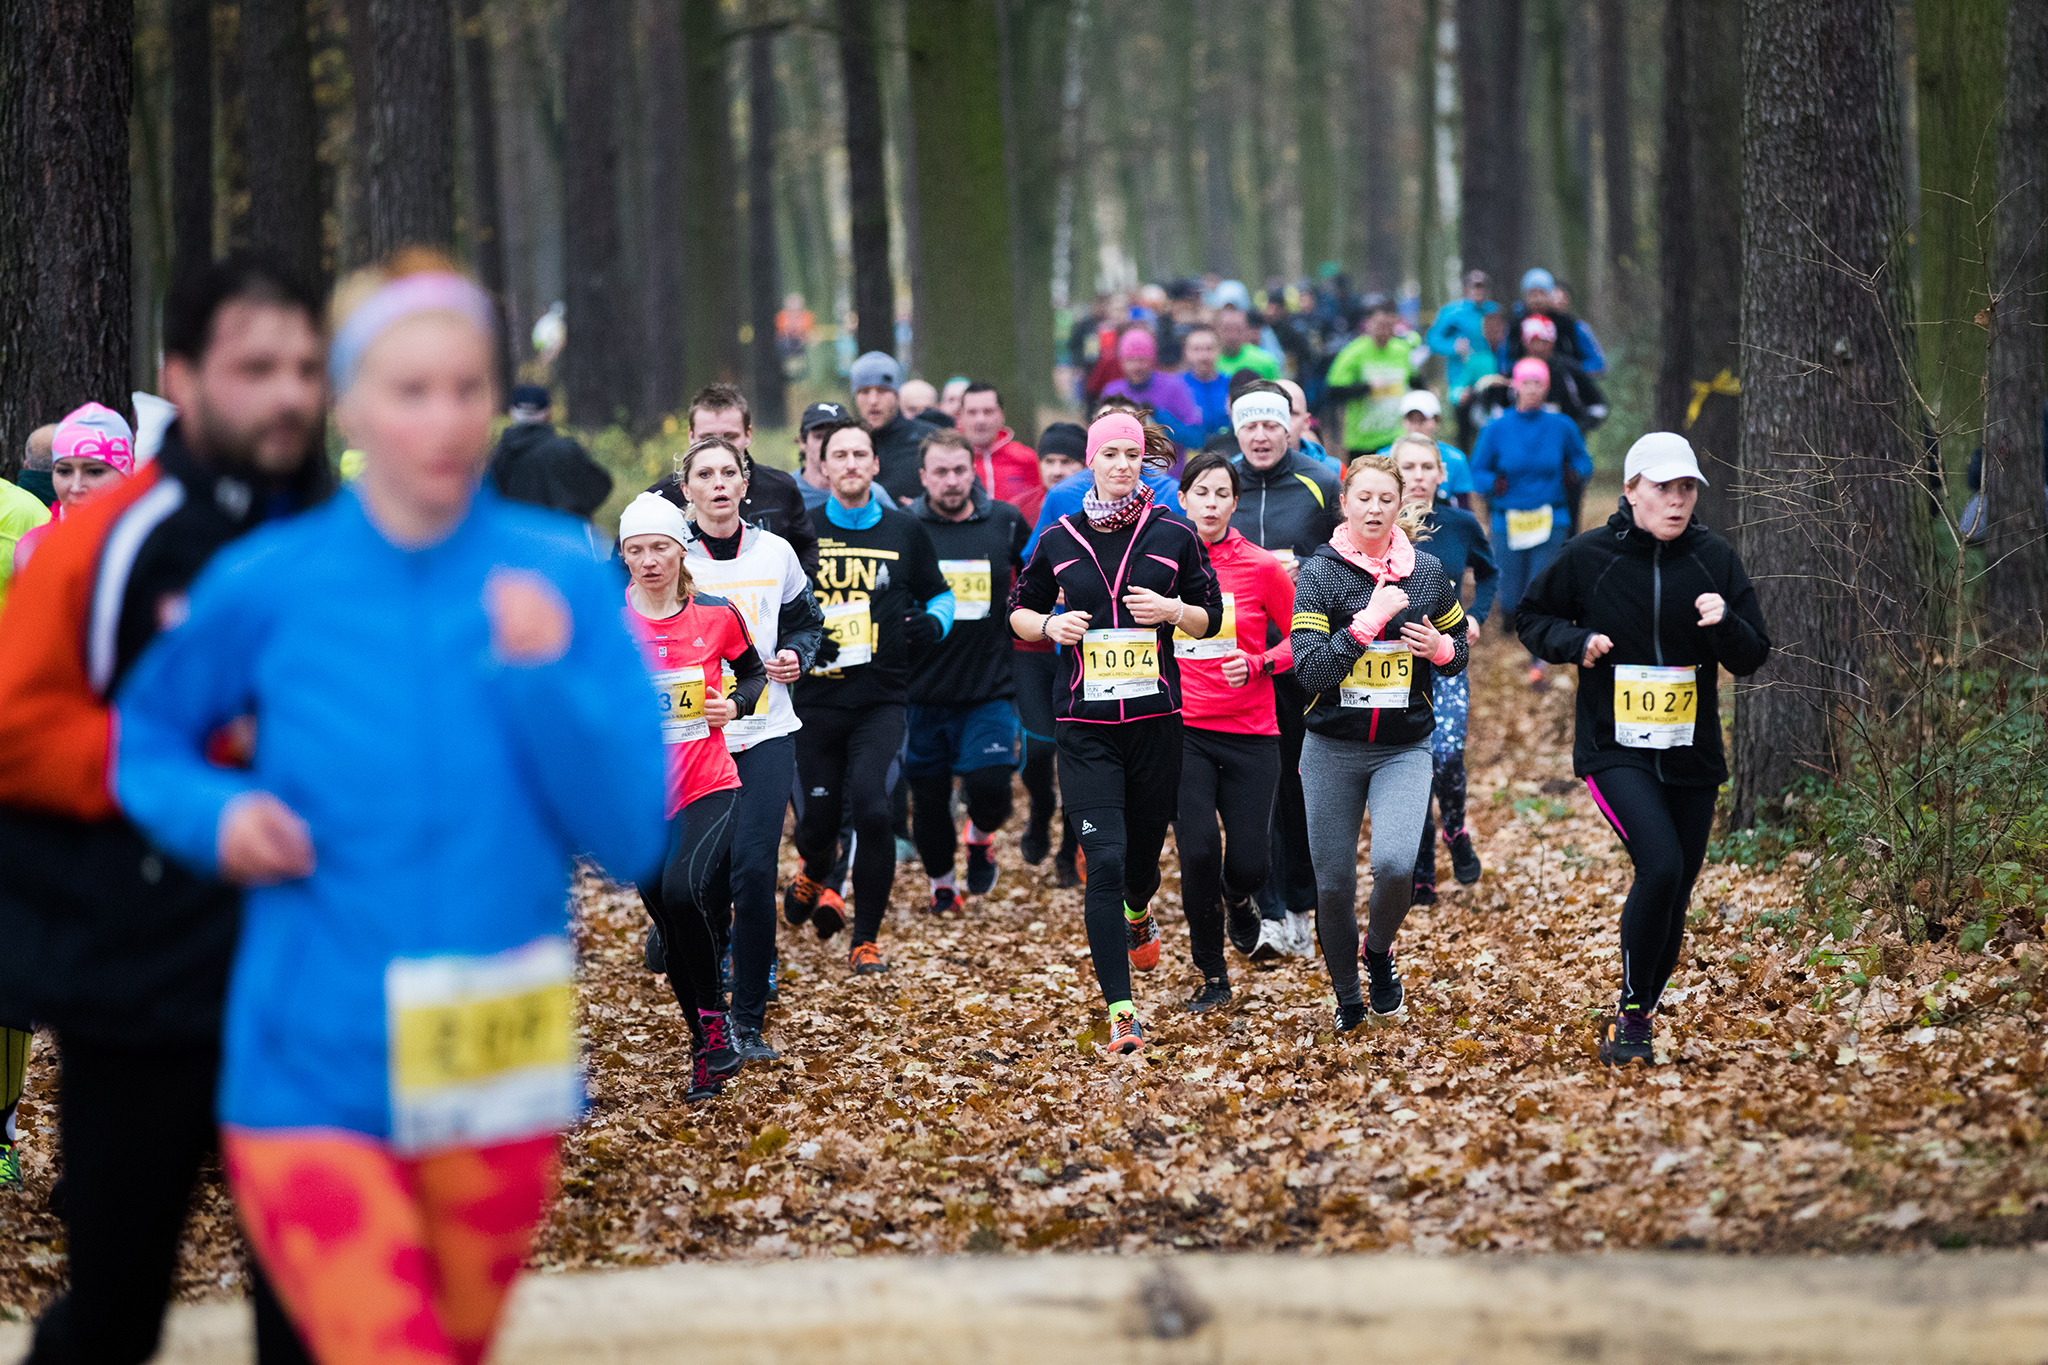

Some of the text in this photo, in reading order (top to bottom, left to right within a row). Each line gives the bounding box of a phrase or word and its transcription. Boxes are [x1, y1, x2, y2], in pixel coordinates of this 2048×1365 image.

[816, 557, 877, 590] RUN
[1089, 649, 1154, 669] 1004
[1623, 690, 1694, 712] 1027
